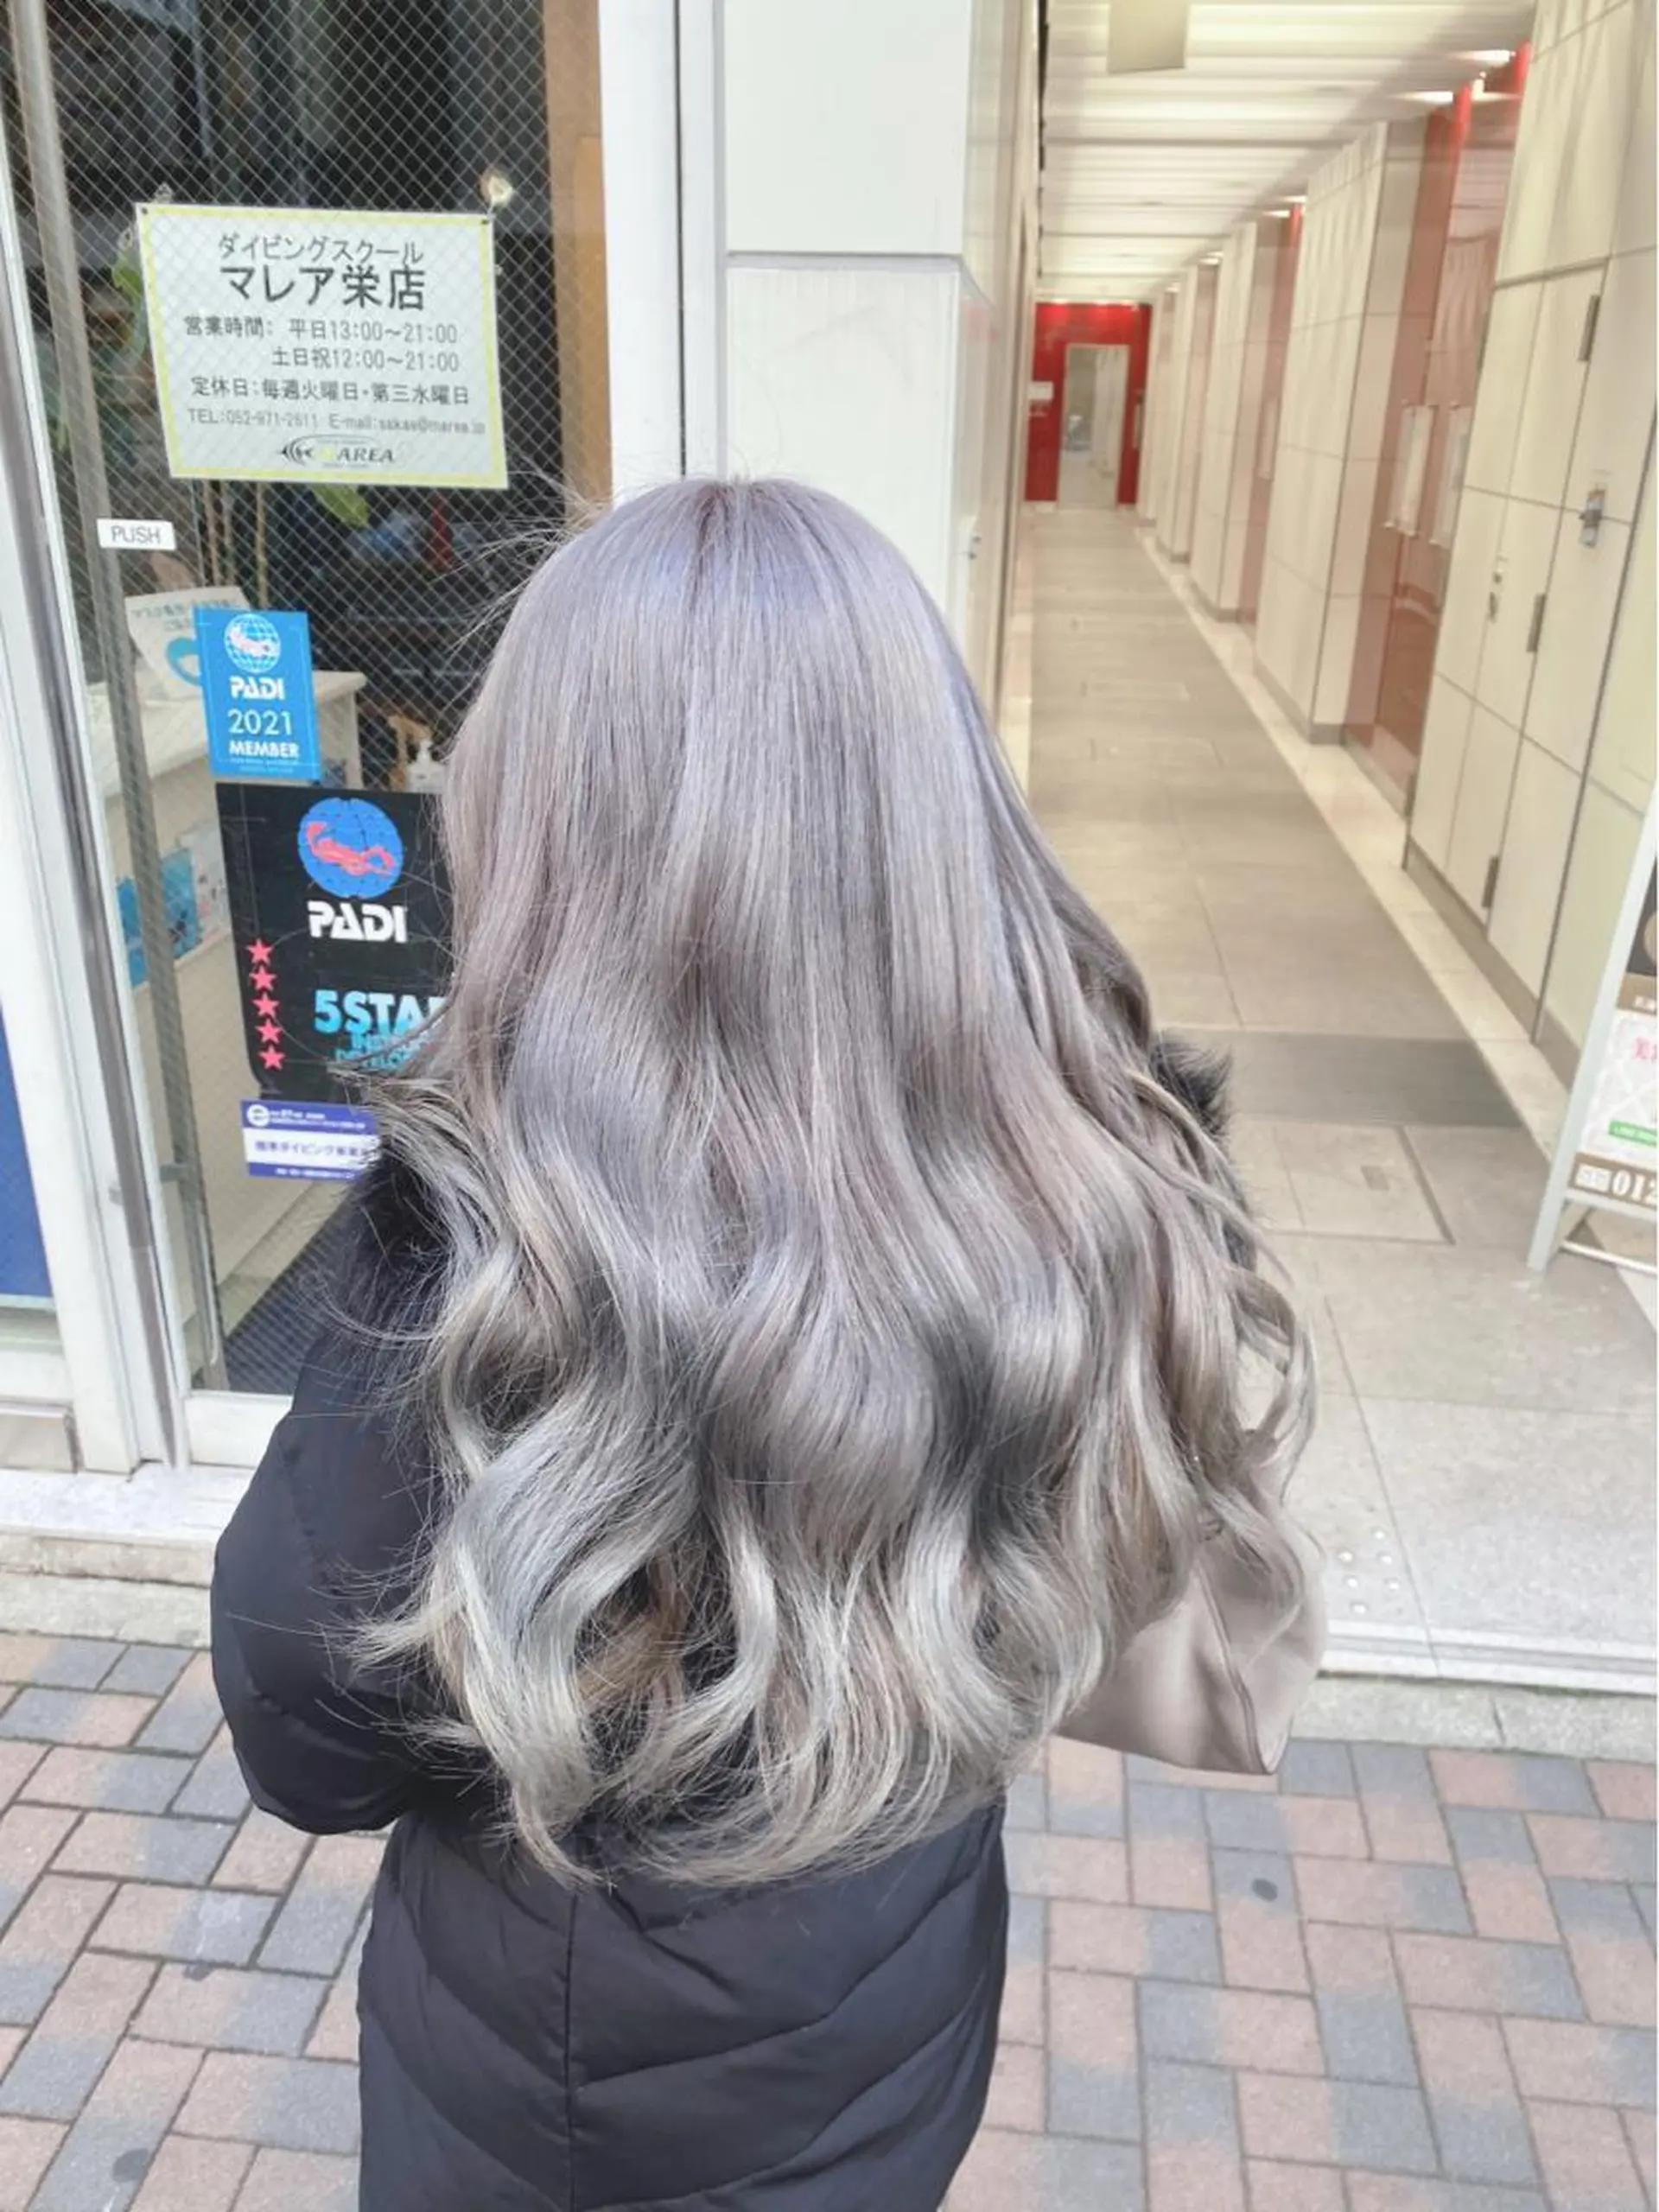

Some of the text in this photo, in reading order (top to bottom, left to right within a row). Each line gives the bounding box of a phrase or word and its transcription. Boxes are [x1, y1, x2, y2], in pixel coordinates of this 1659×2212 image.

[219, 232, 423, 264] ダイビングスクール
[219, 263, 426, 310] マレア栄店
[111, 524, 162, 544] PUSH
[228, 675, 286, 701] PADI
[227, 709, 293, 735] 2021
[228, 740, 300, 759] MEMBER
[308, 899, 409, 944] PADI
